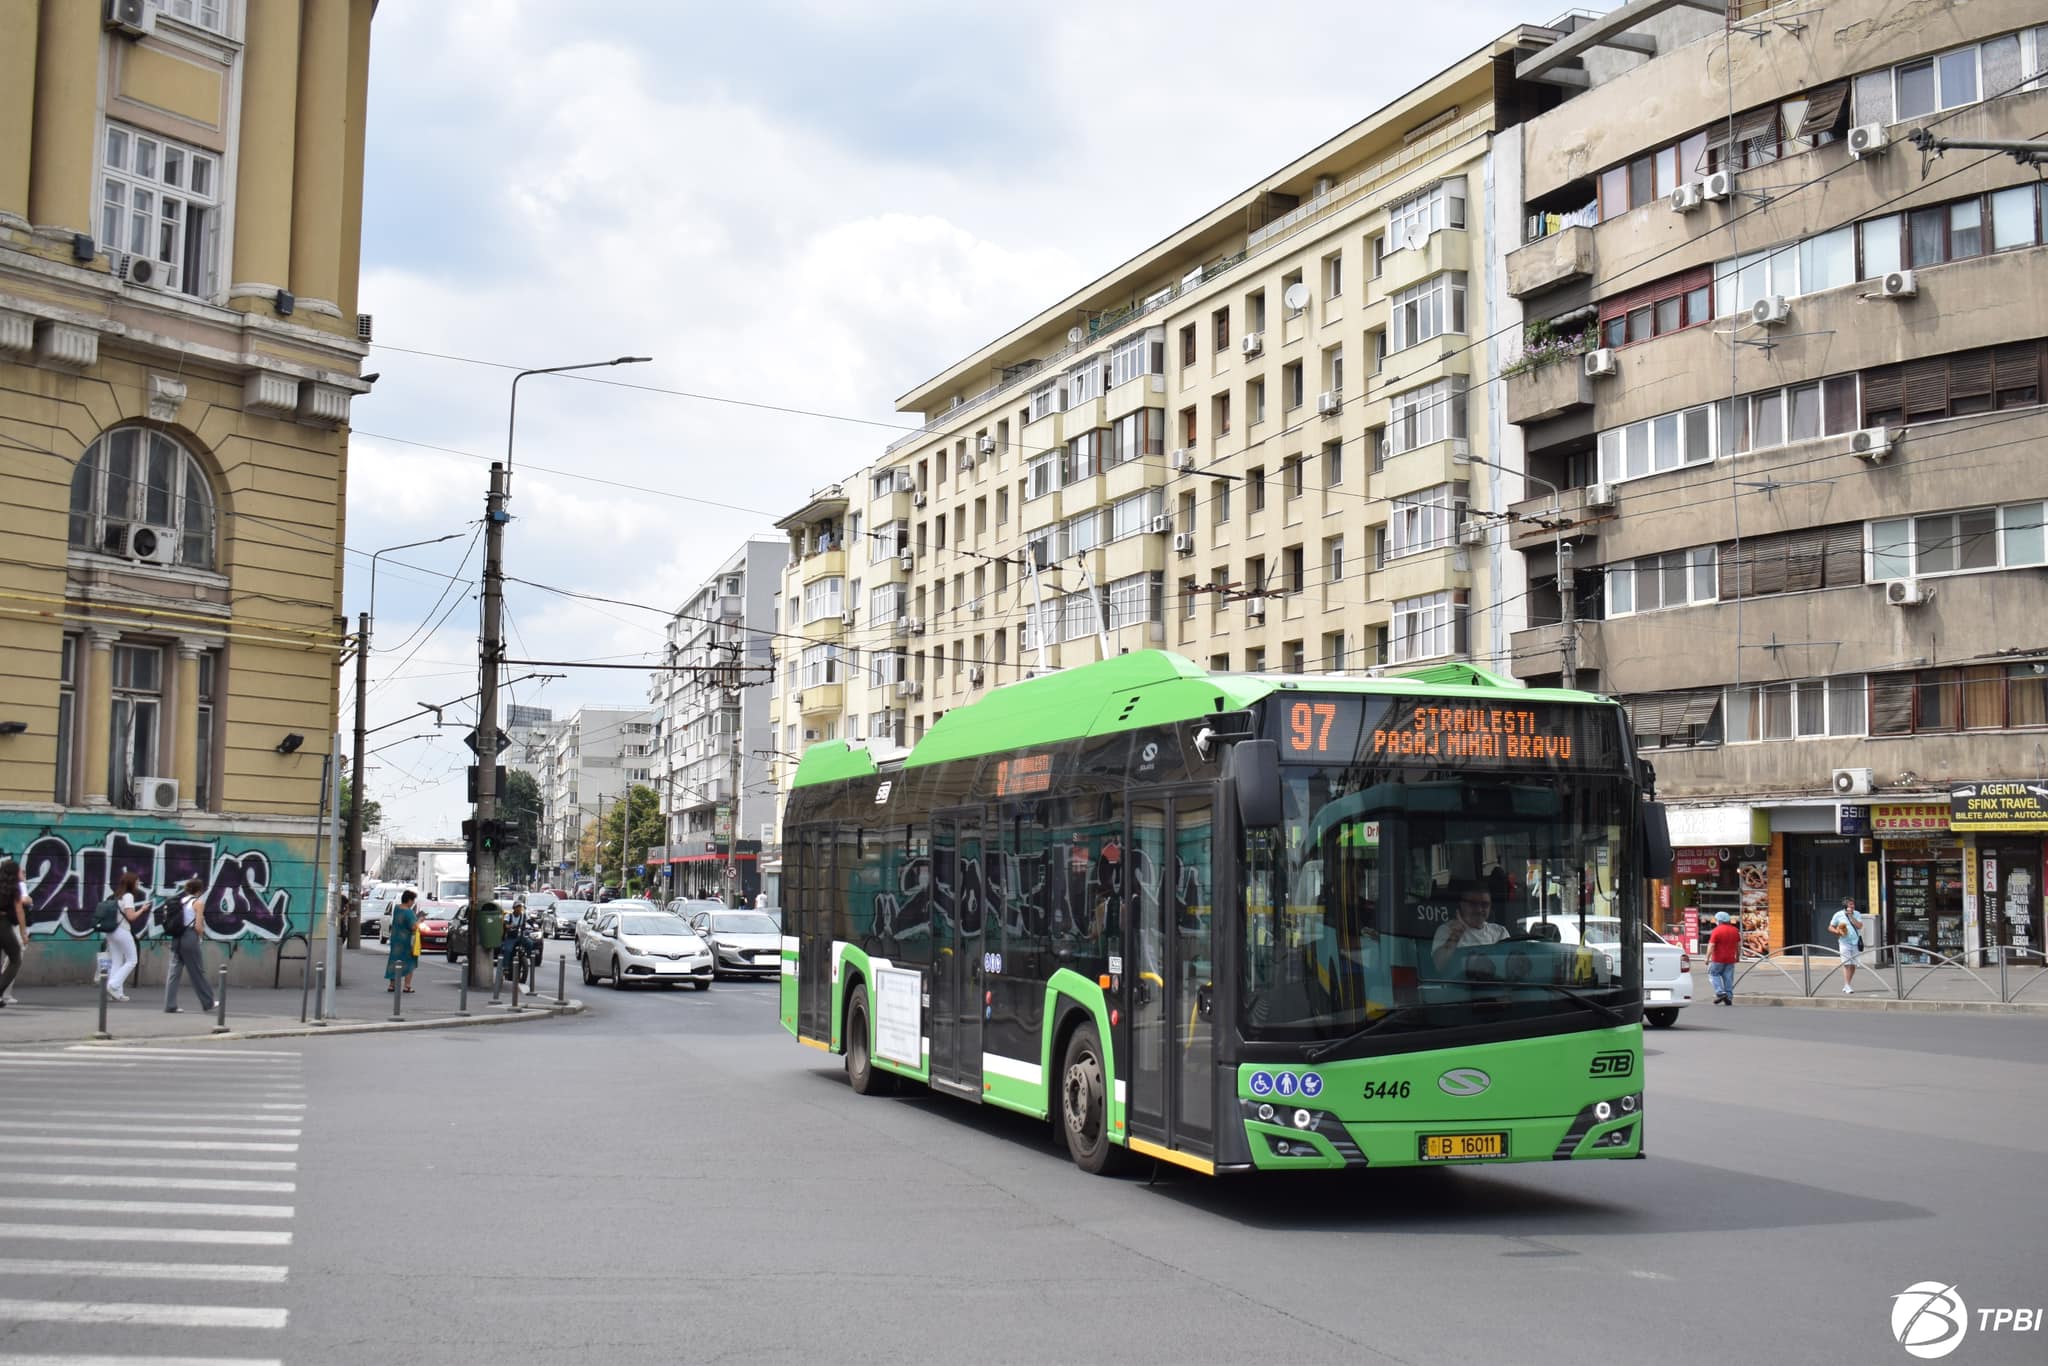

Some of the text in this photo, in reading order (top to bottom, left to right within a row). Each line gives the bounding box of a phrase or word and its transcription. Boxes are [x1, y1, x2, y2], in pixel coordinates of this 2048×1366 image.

[1291, 703, 1336, 751] 97
[1414, 707, 1535, 734] STRAULESTI
[1374, 730, 1571, 759] PASAJ MIHAI BRAVU
[1980, 783, 2027, 796] AGENTIA
[1967, 797, 2040, 810] SFINX TRAVEL
[1955, 811, 1983, 820] BILETE
[1984, 811, 2008, 819] AVION
[1985, 861, 1994, 889] RCA
[1589, 1053, 1632, 1074] STB
[1363, 1080, 1411, 1099] 5446
[1442, 1136, 1495, 1154] B 16011
